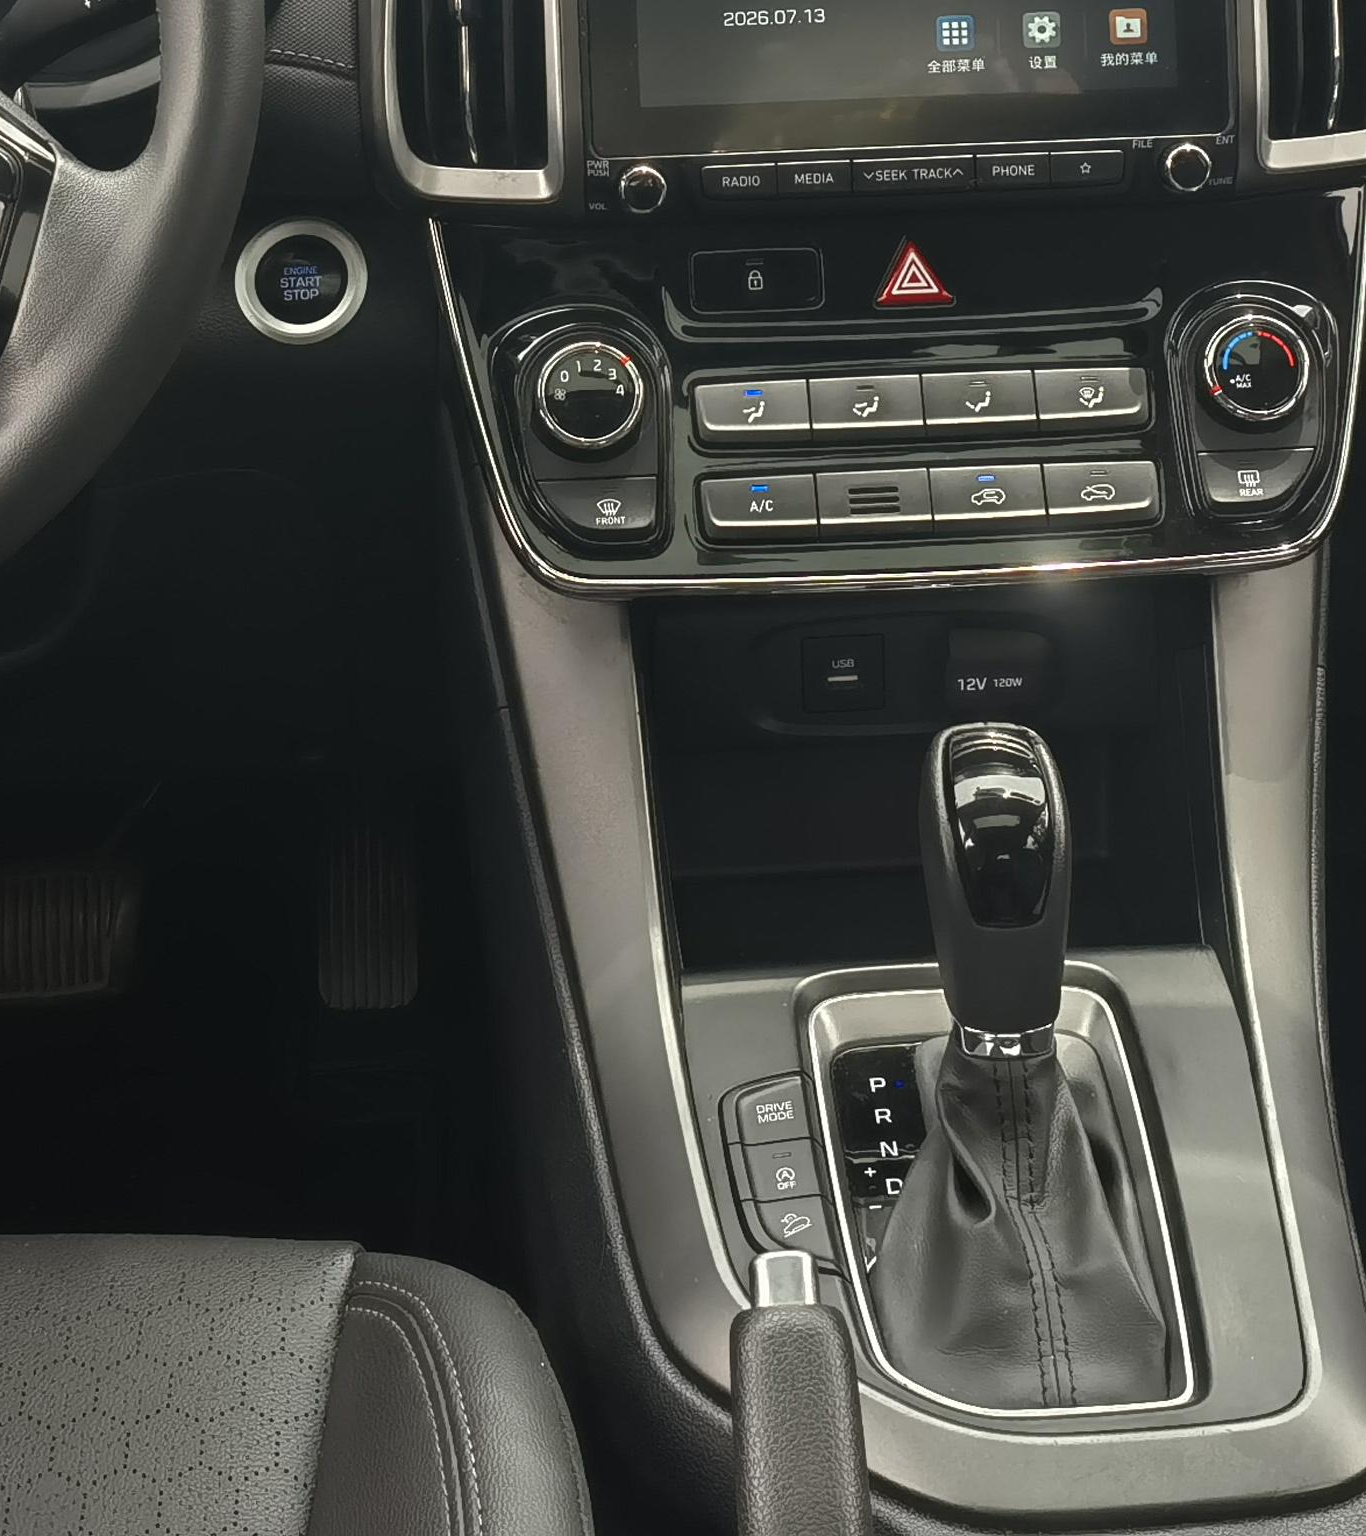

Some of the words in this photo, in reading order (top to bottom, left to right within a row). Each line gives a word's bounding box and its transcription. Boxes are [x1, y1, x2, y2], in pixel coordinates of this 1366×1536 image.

[723, 7, 826, 27] 2026.07.13
[1029, 55, 1058, 70] 设置
[1100, 51, 1158, 67] 我的菜单
[927, 58, 986, 74] 全部菜单
[1132, 139, 1153, 149] FILE
[1216, 134, 1234, 145] ENT
[875, 168, 907, 182] SEEK
[912, 167, 953, 181] TRACK
[992, 164, 1035, 177] PHONE
[722, 175, 761, 188] RADIO
[794, 171, 834, 185] MEDIA
[588, 202, 608, 211] VOL
[283, 266, 318, 276] ENGINE
[280, 275, 323, 289] START
[283, 288, 320, 301] STOP
[575, 360, 582, 373] 1
[593, 359, 603, 372] 2
[560, 370, 570, 383] 0
[607, 368, 617, 381] 3
[1235, 373, 1251, 382] A/C
[615, 384, 625, 397] 4
[1236, 381, 1252, 389] MAX
[1239, 488, 1264, 497] REAR
[750, 500, 774, 513] A/C
[596, 516, 626, 526] FRONT
[831, 658, 855, 669] USB
[957, 677, 987, 691] 12V
[993, 677, 1023, 688] 120W
[869, 1077, 886, 1093] P
[755, 1100, 793, 1114] DRIVE
[757, 1110, 795, 1124] MODE
[874, 1108, 892, 1124] R
[879, 1140, 899, 1157] N
[777, 1180, 796, 1190] OFF
[885, 1178, 903, 1195] D
